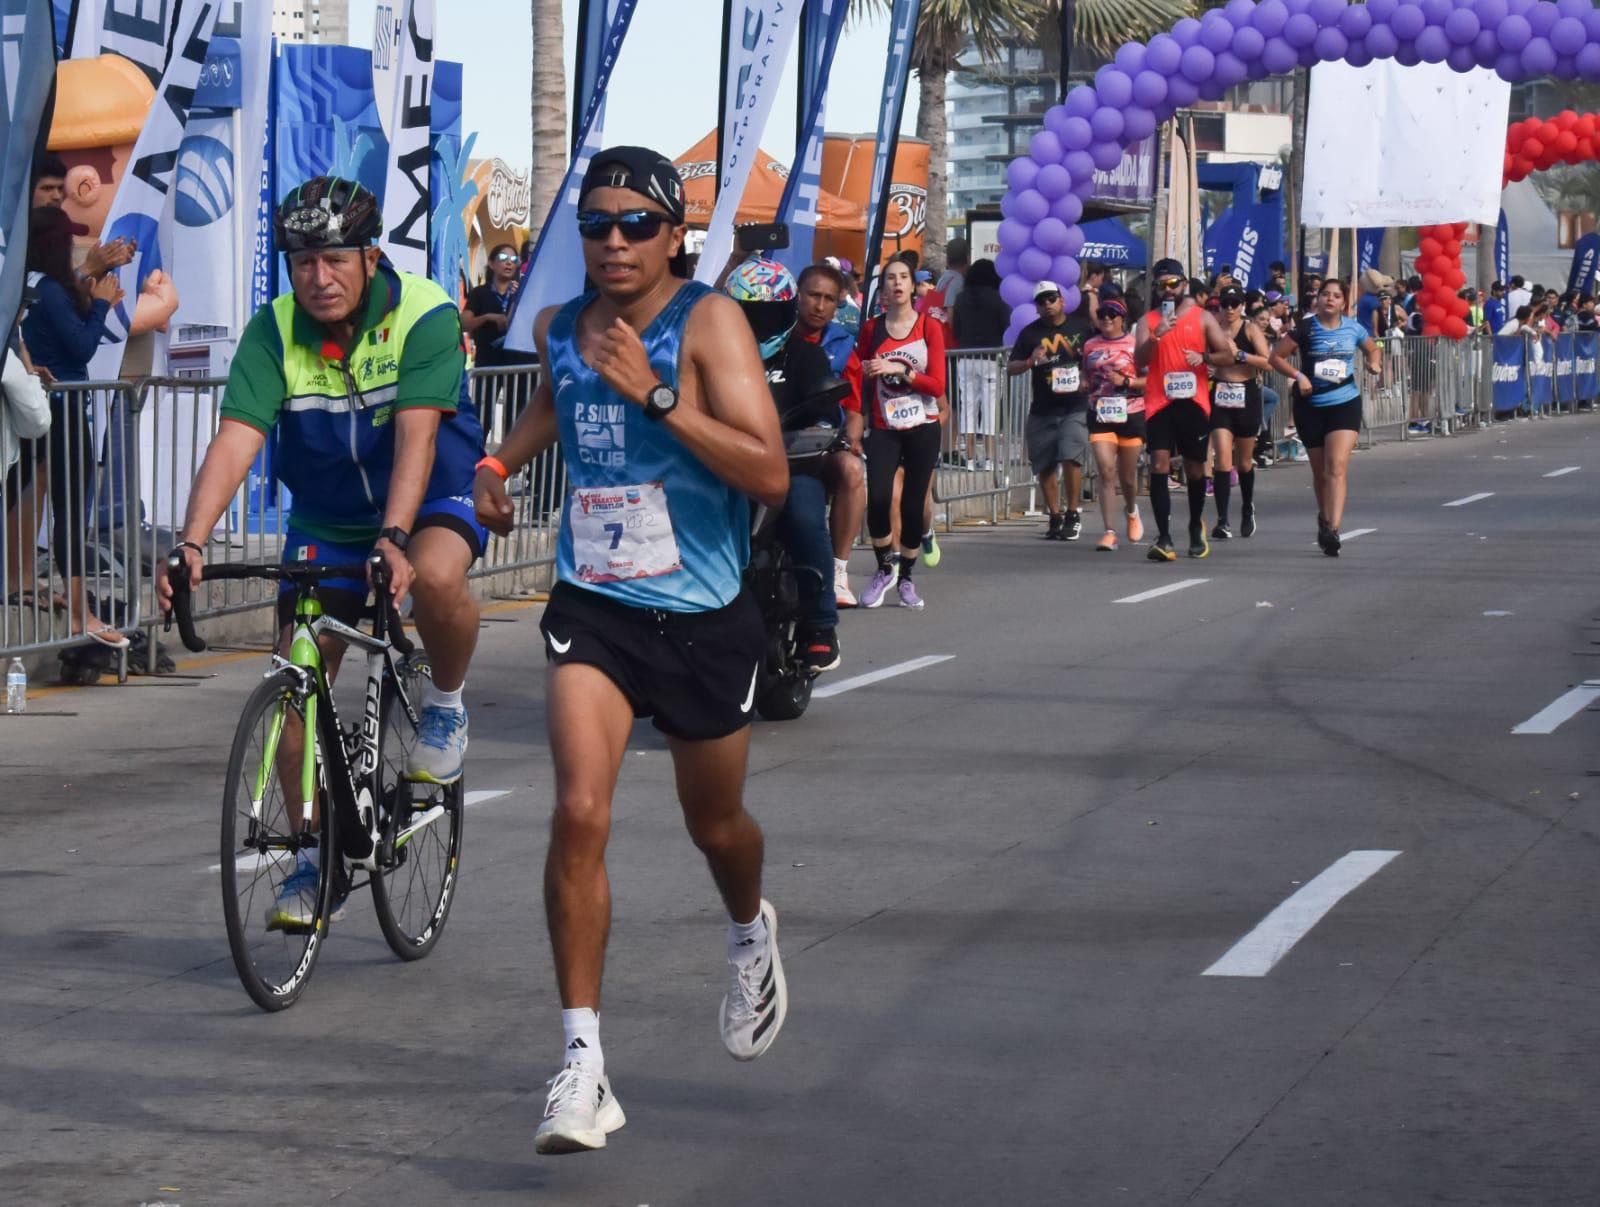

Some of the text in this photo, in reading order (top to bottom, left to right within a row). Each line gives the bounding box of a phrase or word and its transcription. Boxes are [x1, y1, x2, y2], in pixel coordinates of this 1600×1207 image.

[1233, 226, 1259, 289] enis
[588, 404, 625, 423] SILVA
[892, 405, 919, 419] 4017
[579, 447, 625, 467] CLUB
[603, 523, 624, 550] 7
